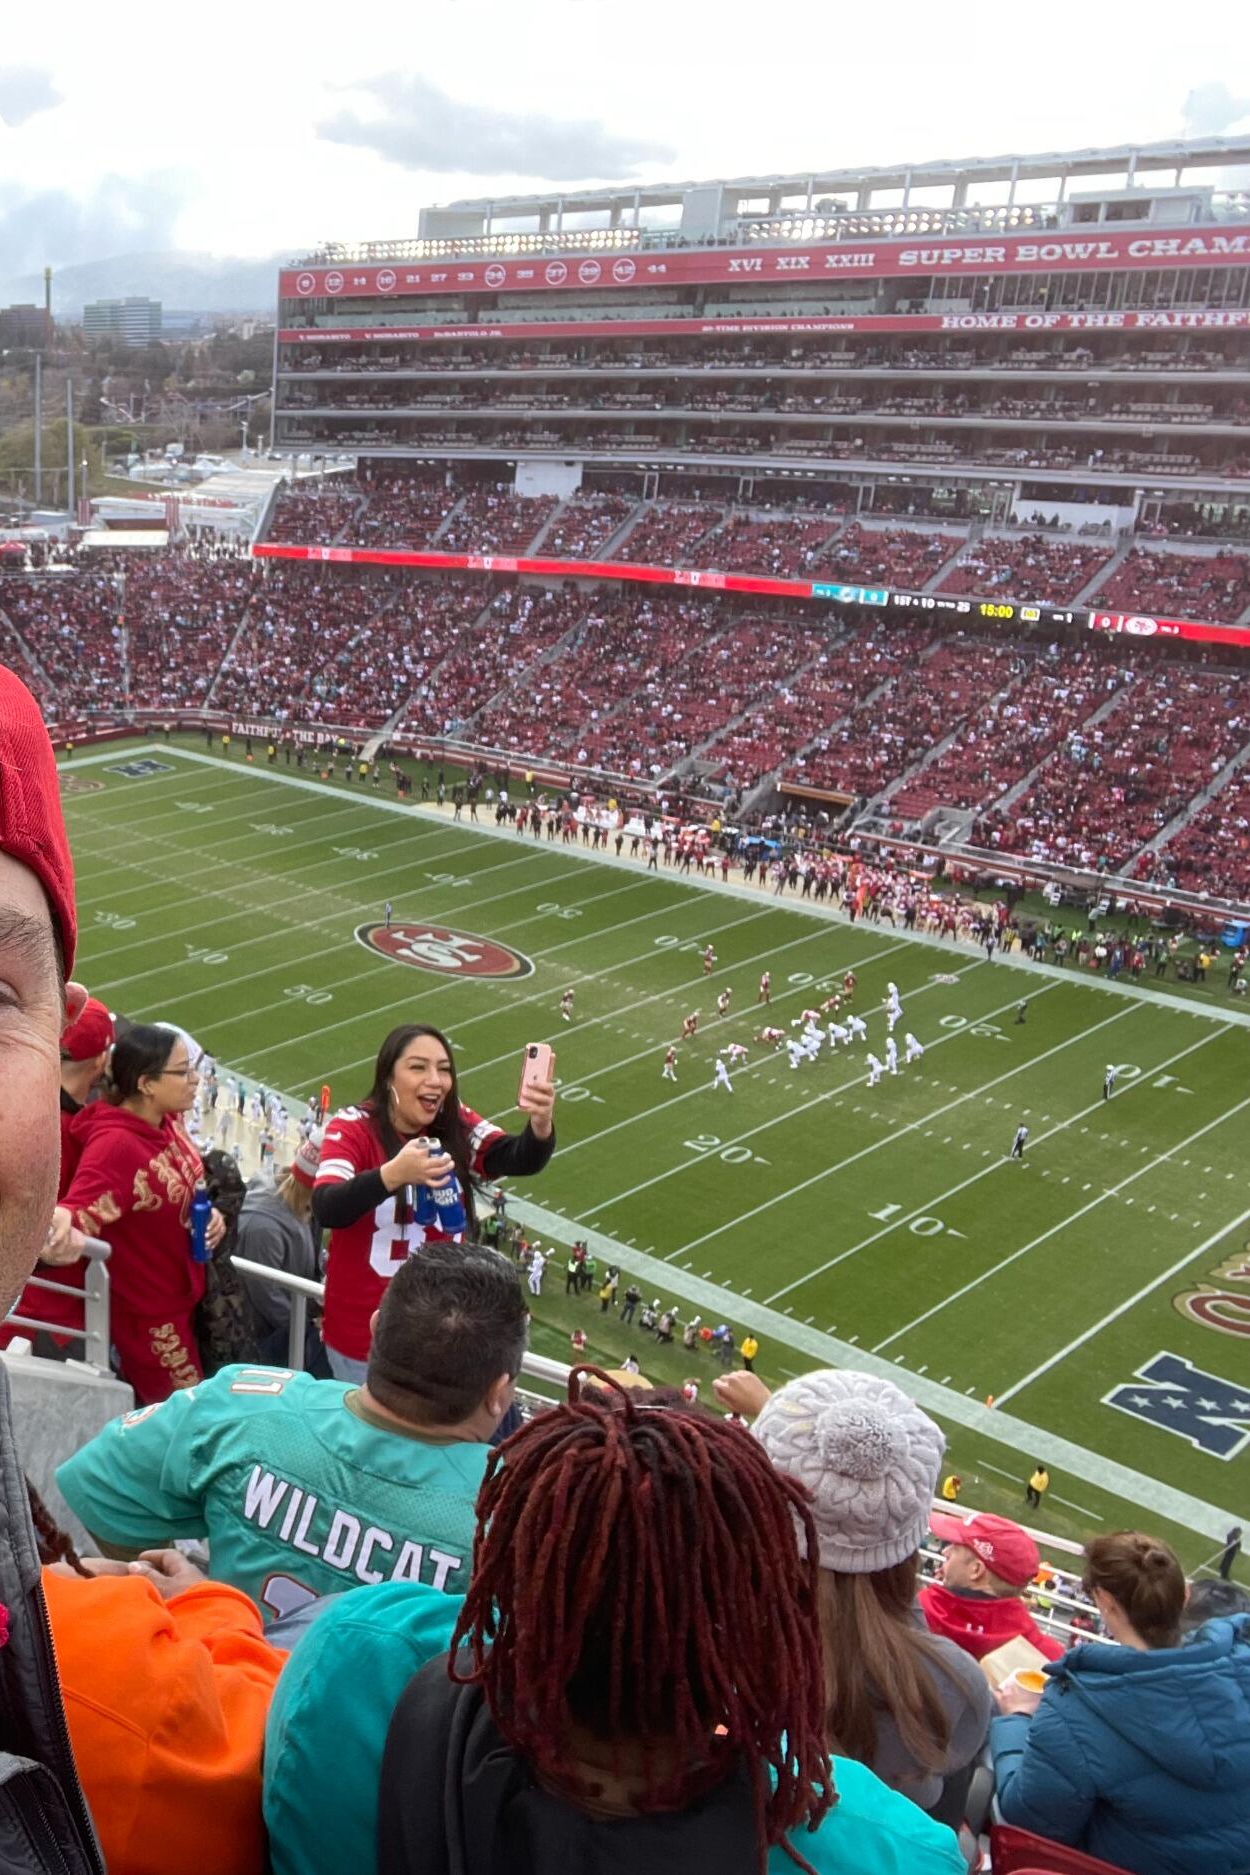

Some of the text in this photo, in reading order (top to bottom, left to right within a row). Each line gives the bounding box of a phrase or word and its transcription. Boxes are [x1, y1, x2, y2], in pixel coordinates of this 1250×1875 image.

[727, 253, 876, 272] XVI XIX XXIII
[898, 235, 1250, 266] SUPER BOWL CHAM
[941, 312, 1250, 329] HOME OF THE FAITHF
[979, 602, 1014, 619] 15:00
[292, 729, 314, 743] THE
[683, 1134, 753, 1164] 20
[867, 1202, 945, 1236] 10
[243, 1464, 463, 1593] WILDCAT
